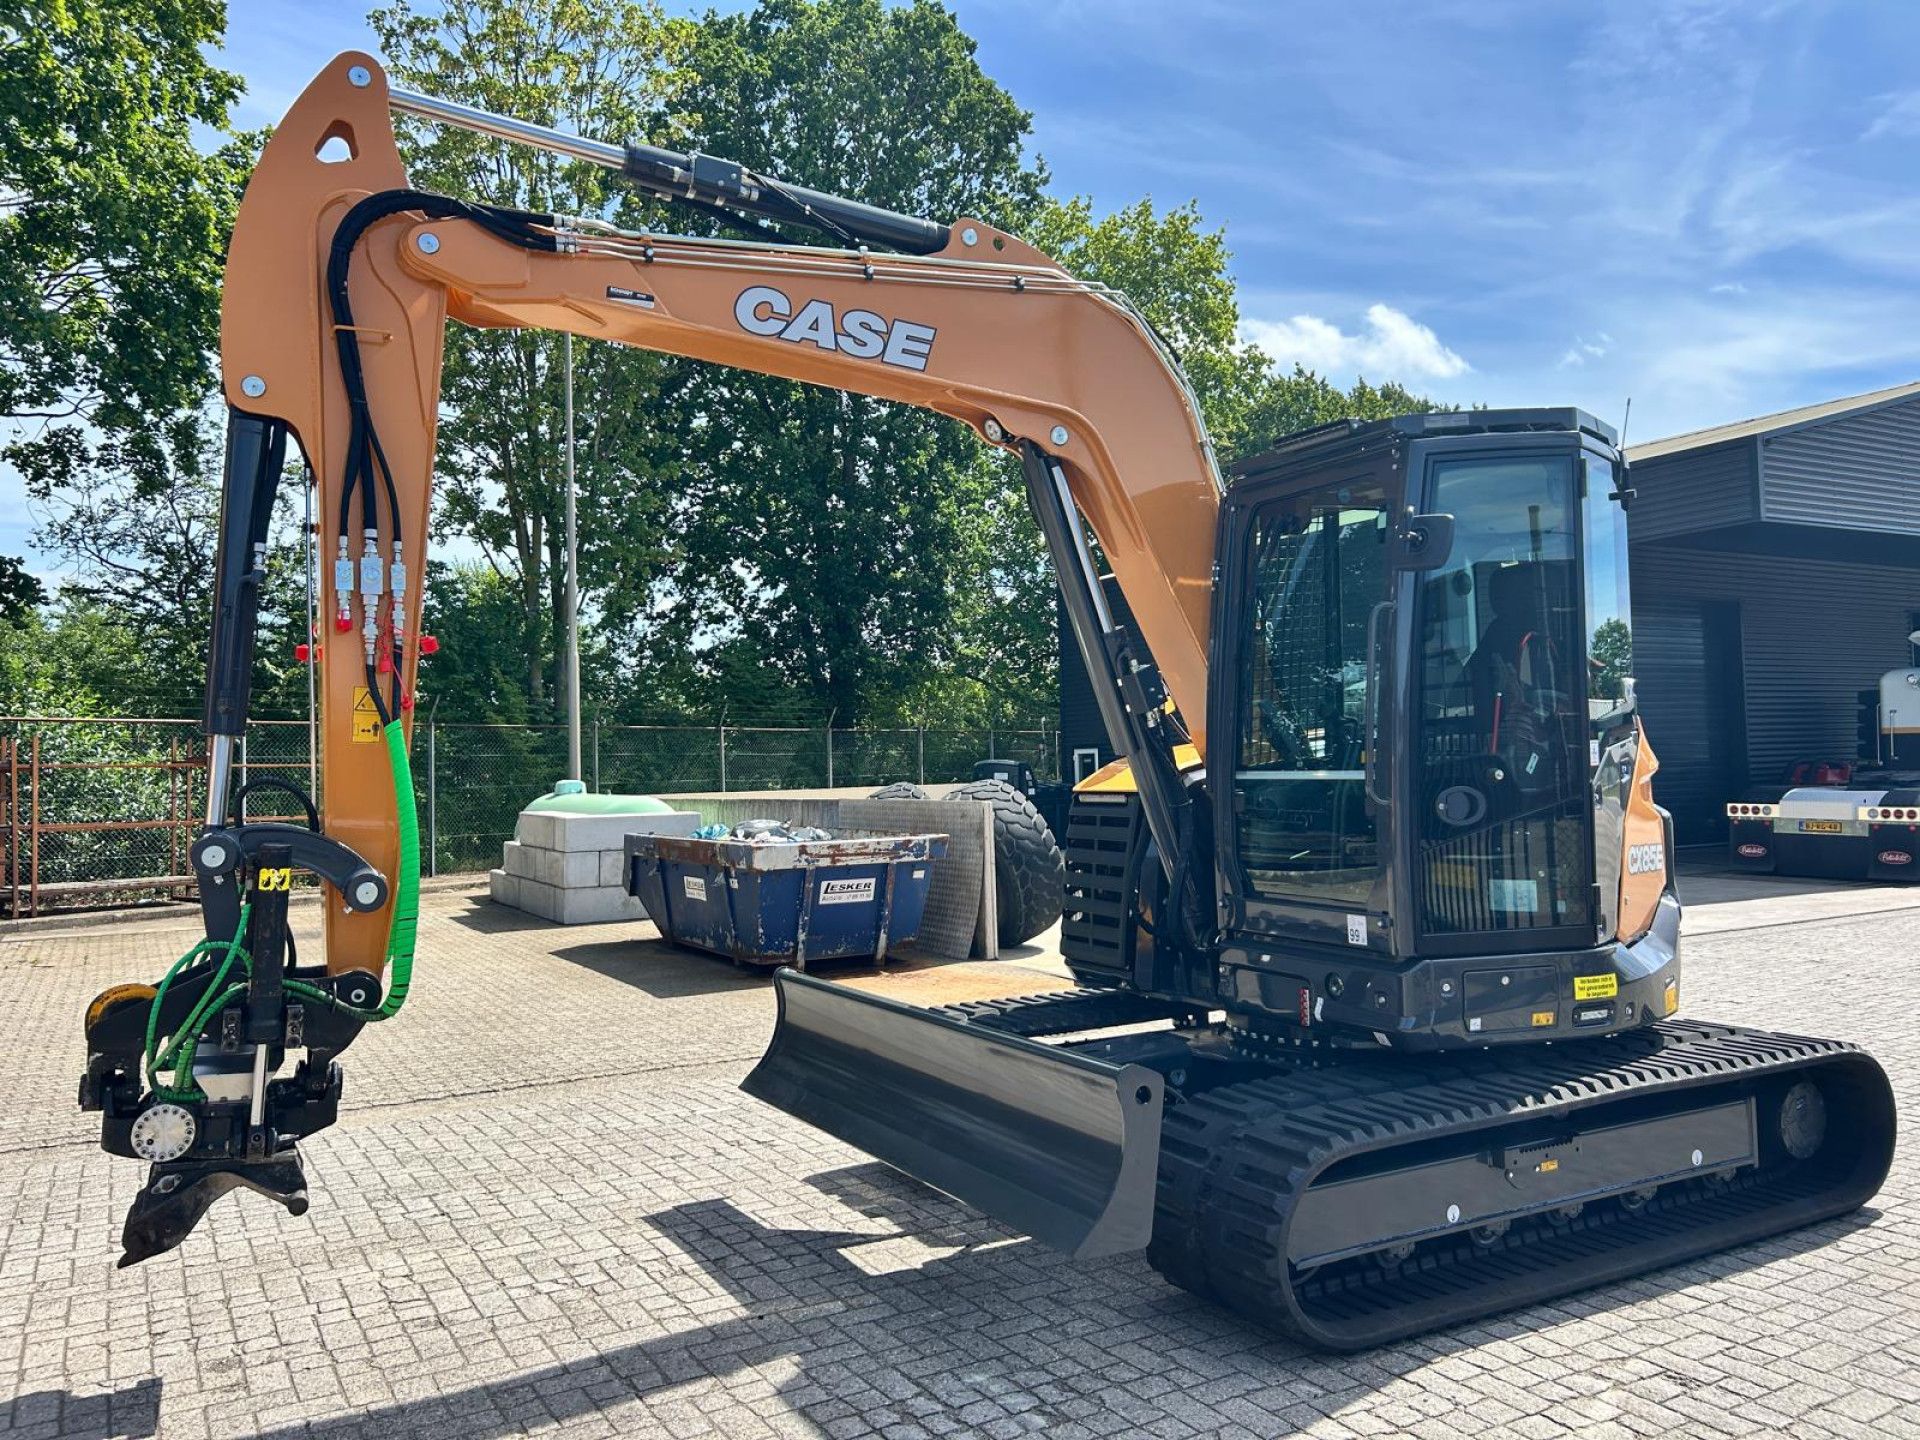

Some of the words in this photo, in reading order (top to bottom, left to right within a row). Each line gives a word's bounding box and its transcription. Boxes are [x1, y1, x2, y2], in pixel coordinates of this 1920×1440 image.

[733, 285, 938, 372] CASE
[1628, 844, 1663, 875] CX85E
[823, 882, 872, 894] LESKER
